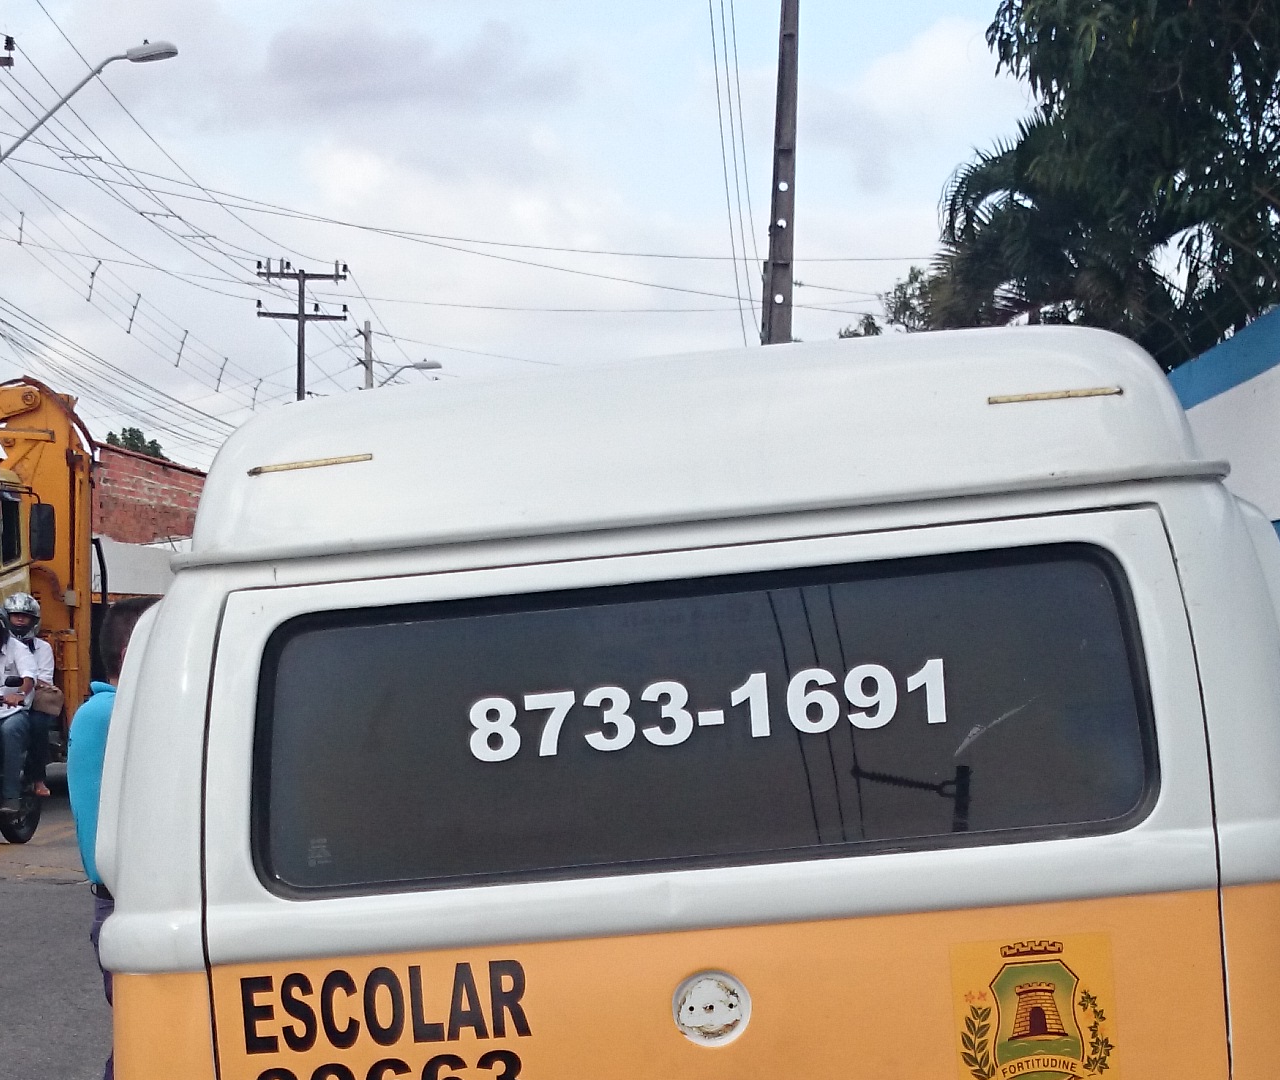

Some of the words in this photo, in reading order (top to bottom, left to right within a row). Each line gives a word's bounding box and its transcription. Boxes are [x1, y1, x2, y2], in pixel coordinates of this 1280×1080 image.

[468, 657, 948, 763] 8733-1691
[240, 959, 533, 1055] ESCOLAR
[1001, 1058, 1078, 1078] FORTITUDINE
